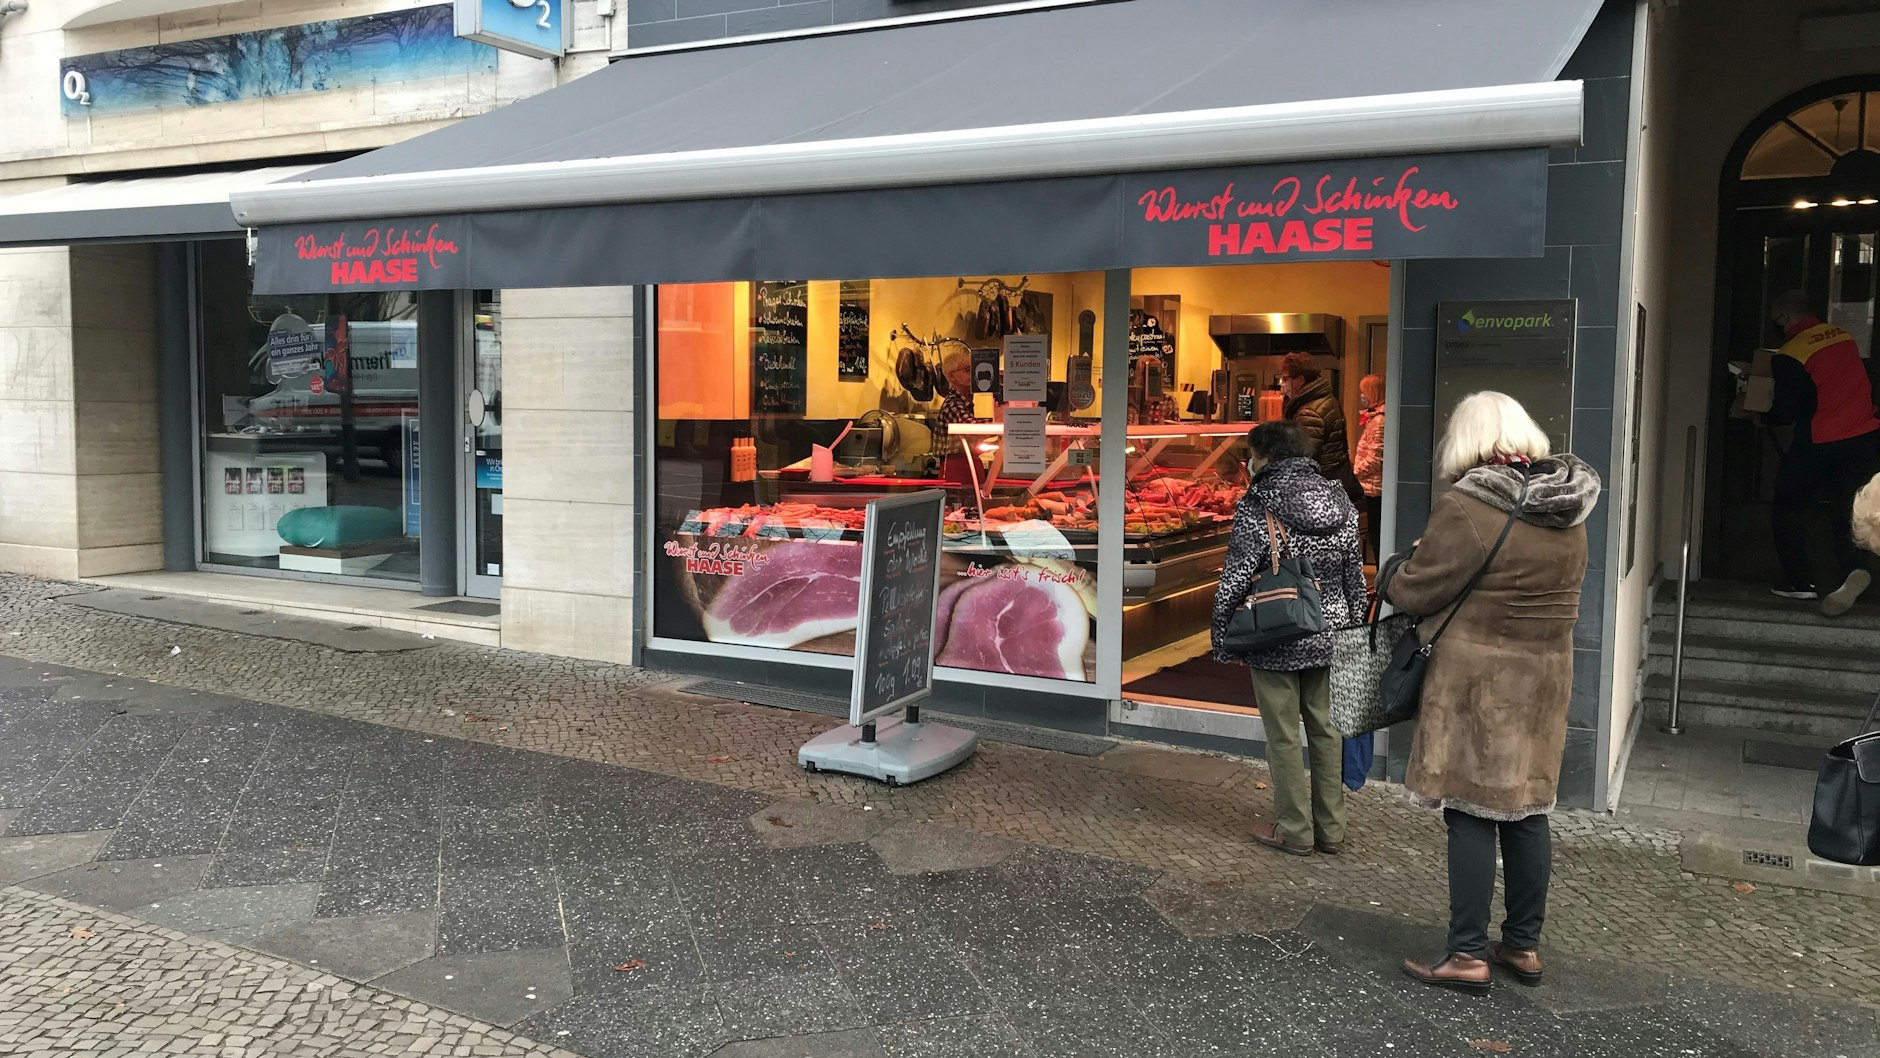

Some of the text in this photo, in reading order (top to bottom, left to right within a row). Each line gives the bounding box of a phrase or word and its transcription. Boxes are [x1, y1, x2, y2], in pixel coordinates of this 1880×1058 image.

[1138, 166, 1457, 232] Wurst und Schinken
[294, 223, 459, 270] Wurst und Schinken
[1208, 217, 1373, 256] HAASE
[331, 258, 418, 285] HAASE
[1475, 313, 1552, 331] envopark
[1810, 327, 1847, 343] DHL
[270, 332, 311, 346] Alles drin für
[271, 342, 319, 357] ein ganzes Jahr
[1009, 360, 1041, 368] 3 Kunden
[887, 520, 927, 551] Empfehlung
[664, 541, 771, 571] Wurst und Schinken
[686, 558, 745, 576] HAASE
[875, 672, 896, 702] 100g
